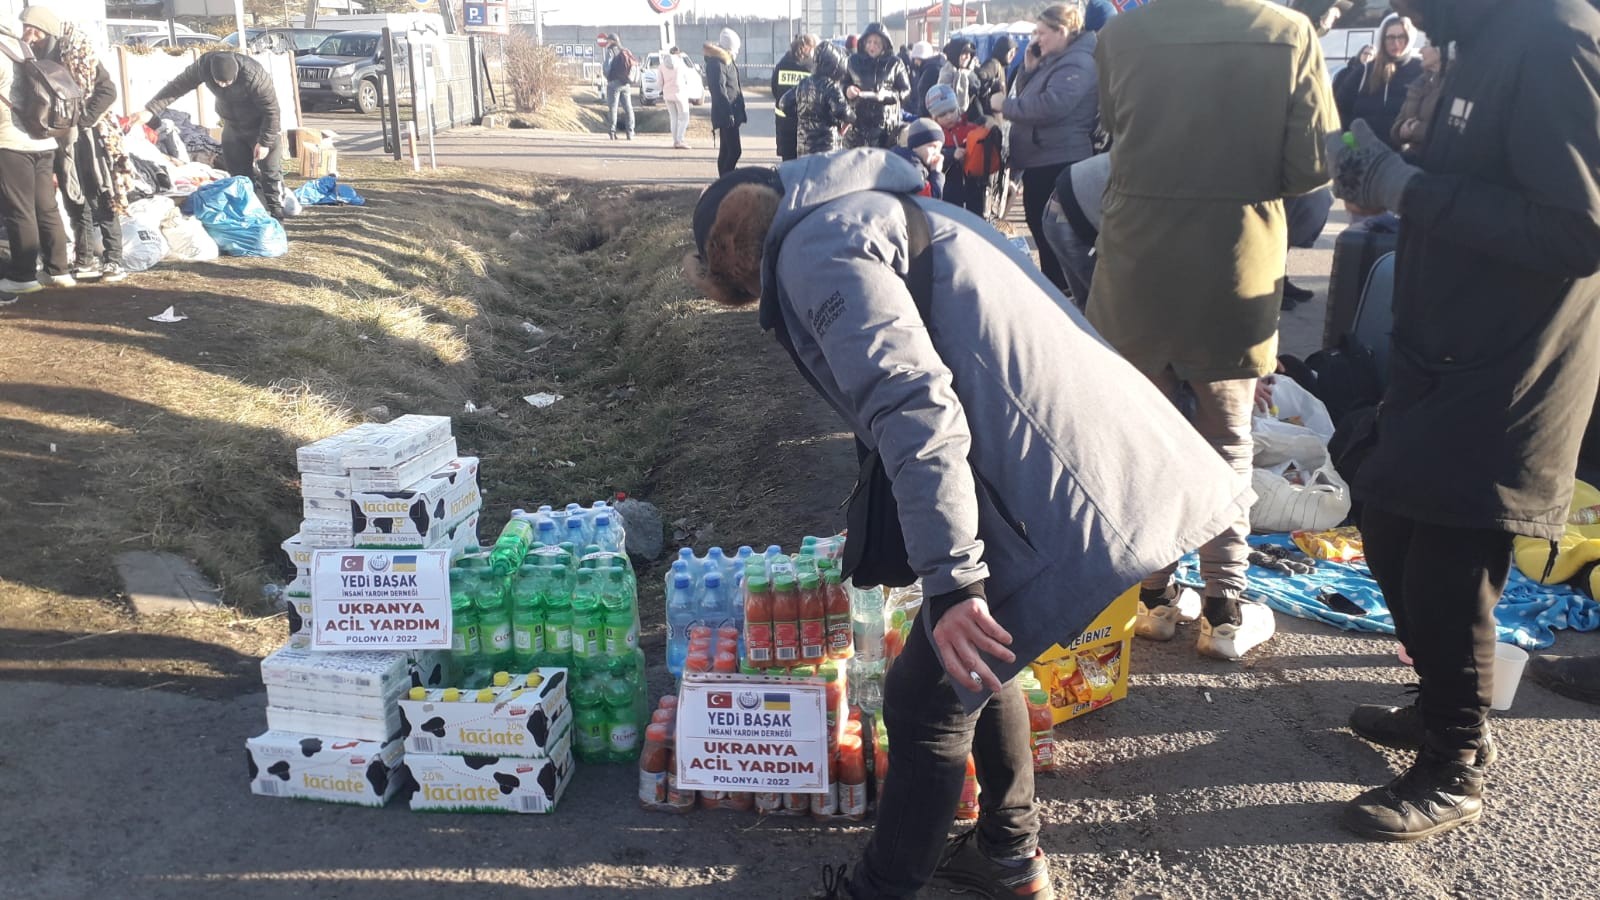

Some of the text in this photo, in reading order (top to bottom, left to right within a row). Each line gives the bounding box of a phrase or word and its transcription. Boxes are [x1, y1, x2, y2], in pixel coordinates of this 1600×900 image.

[469, 7, 479, 20] P
[781, 72, 809, 82] STRA
[373, 574, 418, 589] BAŞAK
[338, 603, 425, 615] UKRANYA
[324, 616, 440, 631] ACİL YARDIM
[346, 635, 389, 643] POLONYA
[396, 635, 418, 643] 2022
[1069, 626, 1112, 651] LEIBNIZ
[743, 712, 792, 728] BAŞAK
[733, 729, 760, 737] YARDIM
[704, 741, 798, 757] UKRANYA
[690, 755, 814, 774] ACİL YARDIM
[713, 775, 759, 785] POLONYA
[767, 777, 790, 786] 2022
